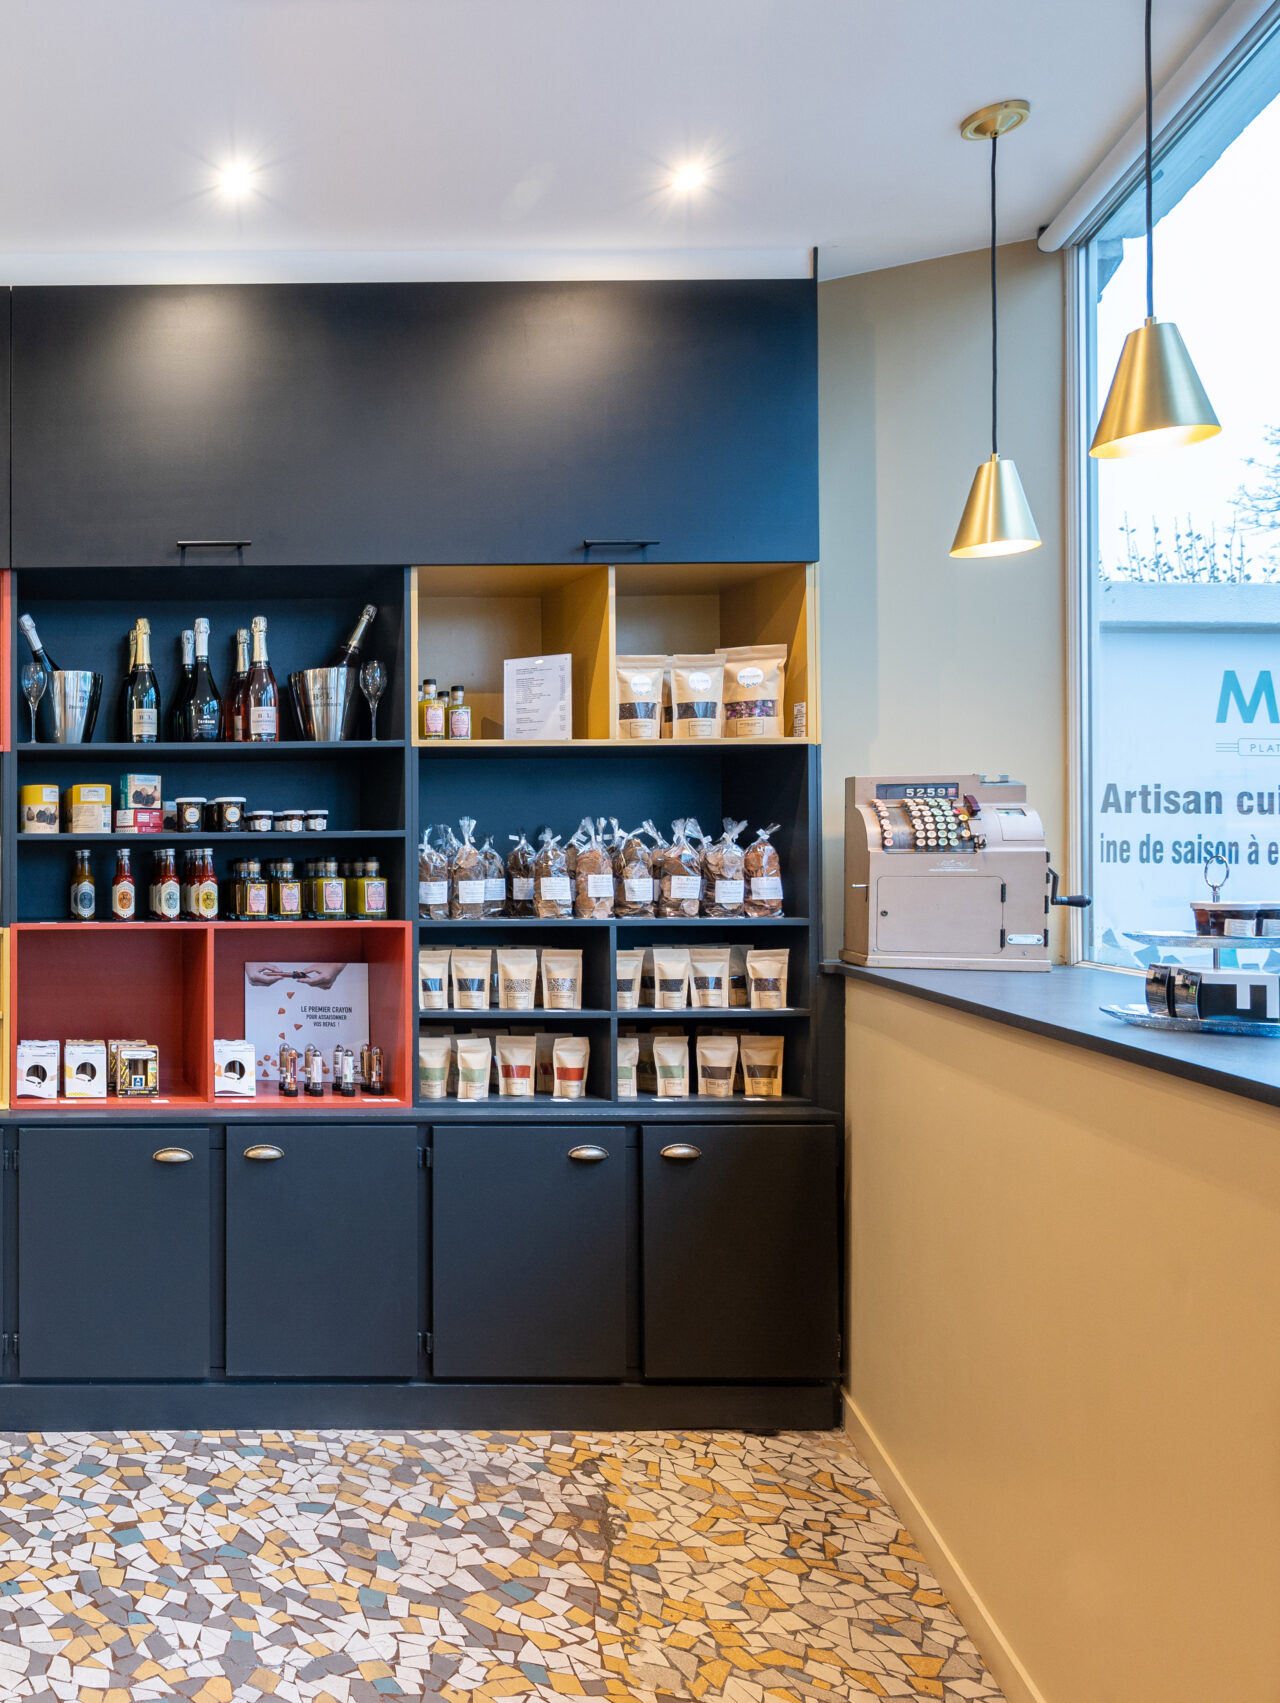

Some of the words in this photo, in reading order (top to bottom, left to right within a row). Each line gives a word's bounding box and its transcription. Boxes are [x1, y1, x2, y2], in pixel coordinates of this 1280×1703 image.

[1101, 783, 1222, 814] Artisan
[1139, 833, 1164, 864] de
[1172, 834, 1239, 865] saison
[1248, 834, 1259, 865] à
